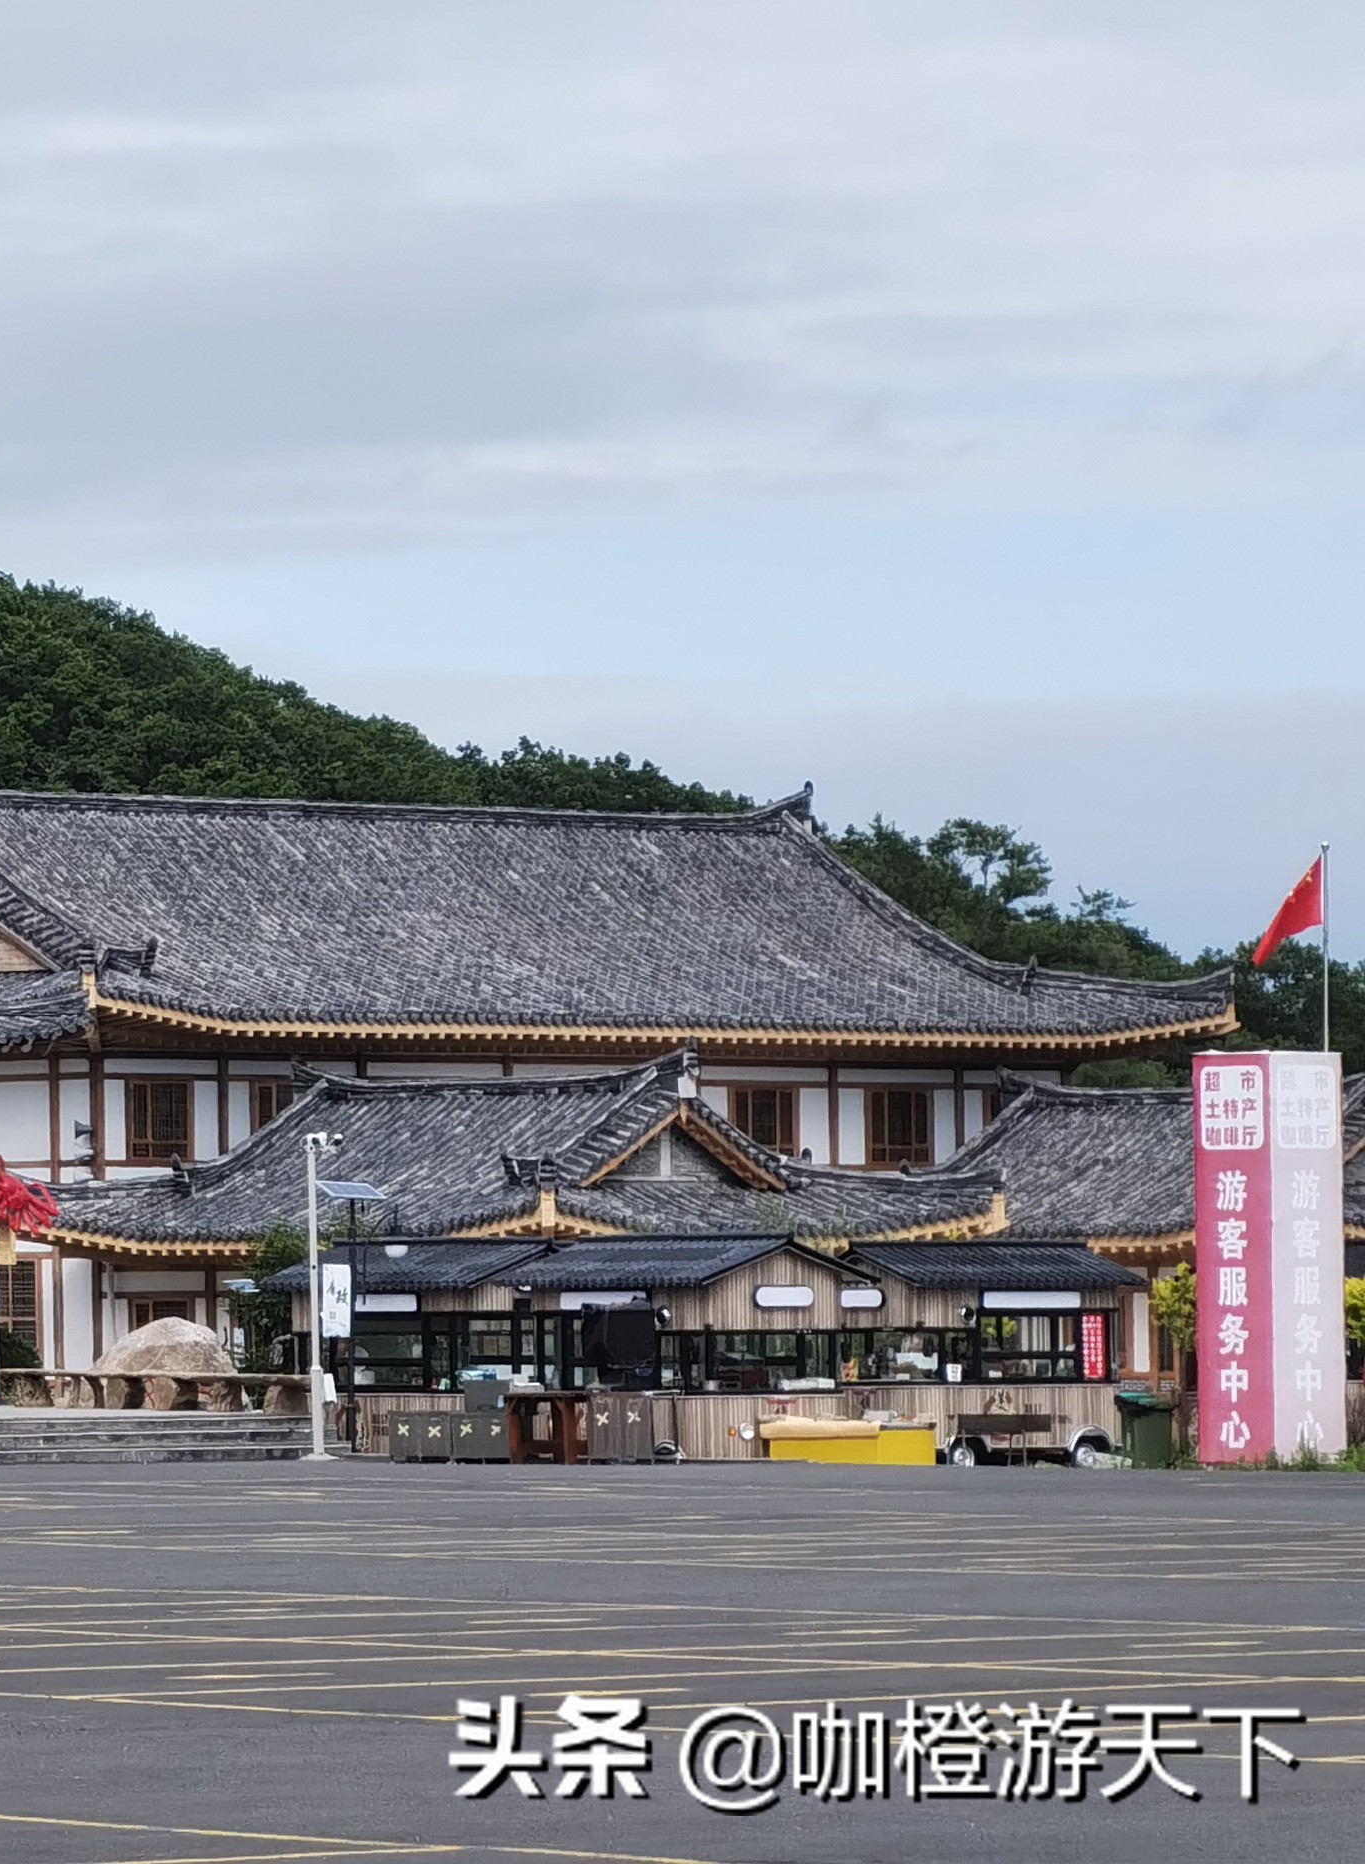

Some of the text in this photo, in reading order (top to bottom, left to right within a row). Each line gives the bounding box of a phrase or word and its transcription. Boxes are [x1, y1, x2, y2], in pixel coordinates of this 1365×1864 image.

[1204, 1098, 1258, 1120] 土特产
[1205, 1125, 1258, 1147] 咖啡厅
[1216, 1169, 1250, 1449] 游客服务中心
[1292, 1168, 1324, 1449] 游客服务中心
